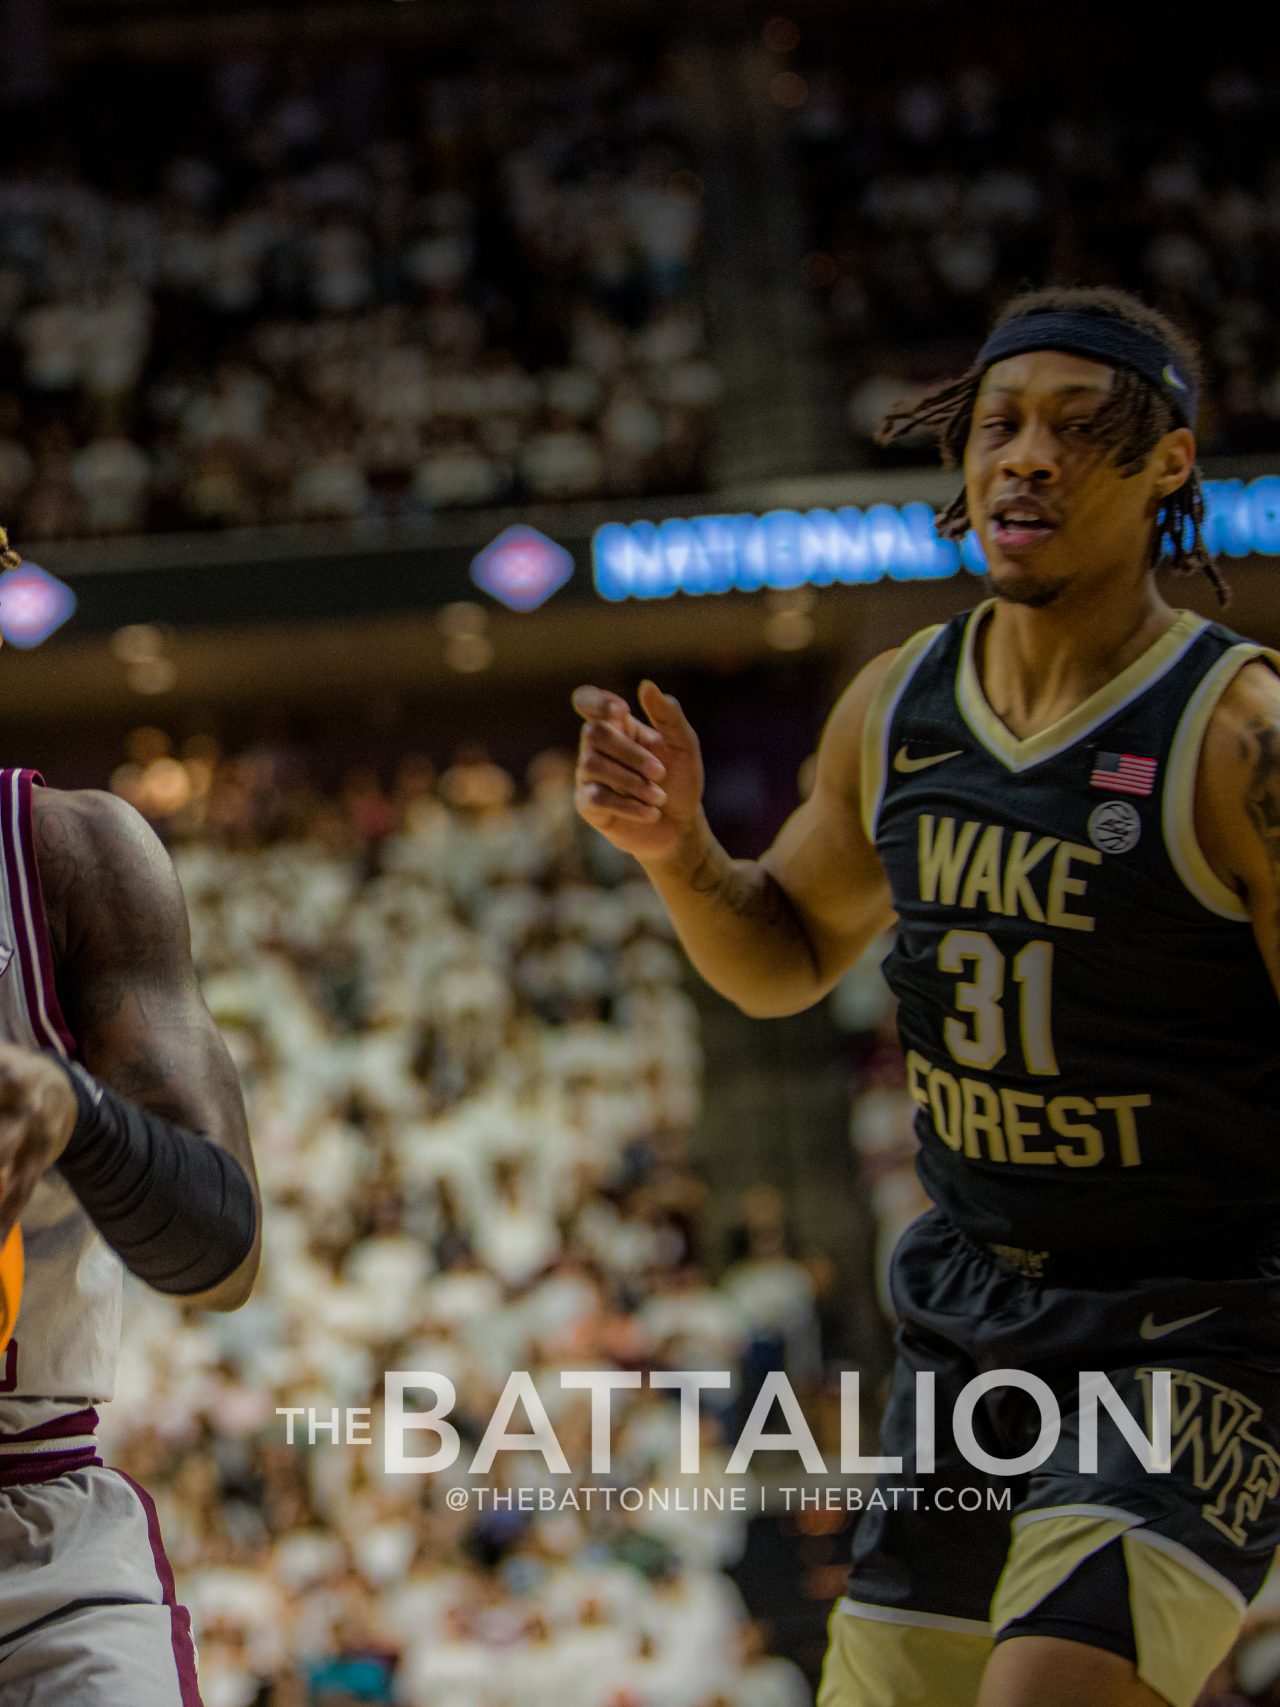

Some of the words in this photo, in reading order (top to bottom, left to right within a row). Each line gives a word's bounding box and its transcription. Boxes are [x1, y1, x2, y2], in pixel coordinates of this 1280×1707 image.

[918, 813, 1102, 932] WAKE
[936, 928, 1060, 1076] 31
[906, 1049, 1151, 1168] FOREST
